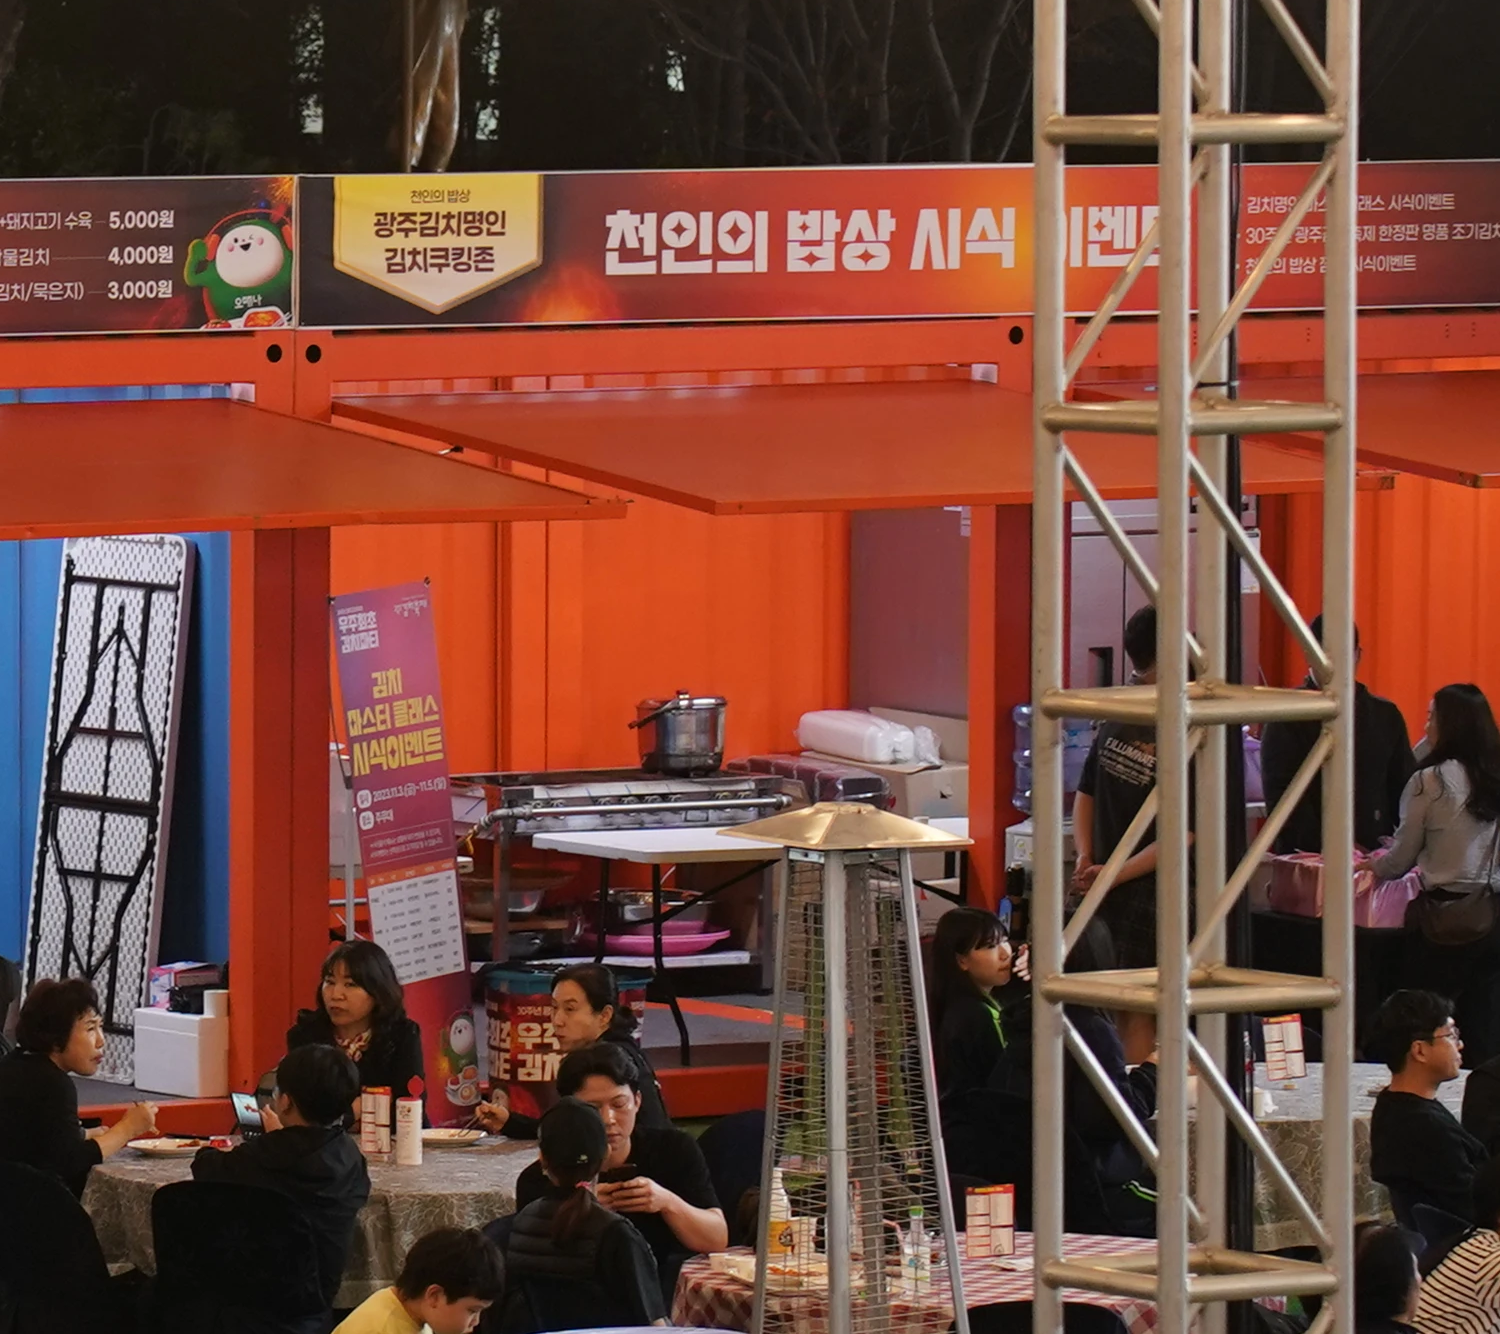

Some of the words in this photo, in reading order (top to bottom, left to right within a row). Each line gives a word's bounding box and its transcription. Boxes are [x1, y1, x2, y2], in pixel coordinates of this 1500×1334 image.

[410, 189, 445, 204] 천인의
[447, 188, 472, 203] 밥상
[1388, 192, 1455, 211] 시식이벤트
[64, 211, 93, 231] 수육
[108, 209, 175, 230] 5,000원
[373, 210, 507, 238] 광주김치명인
[1379, 223, 1420, 242] 한정판
[1422, 222, 1449, 241] 명품
[605, 208, 769, 276] 천인의
[786, 208, 897, 273] 밥상
[909, 206, 1017, 270] 시식
[107, 246, 174, 266] 4,000원
[384, 244, 496, 274] 김치쿠킹존
[107, 279, 173, 300] 3,000원
[337, 610, 378, 633] 우주최초
[340, 629, 380, 654] 김치파티
[371, 667, 404, 699] 김치
[347, 703, 391, 738] 마스터
[392, 695, 440, 728] 클래스
[352, 727, 445, 777] 시식이벤트
